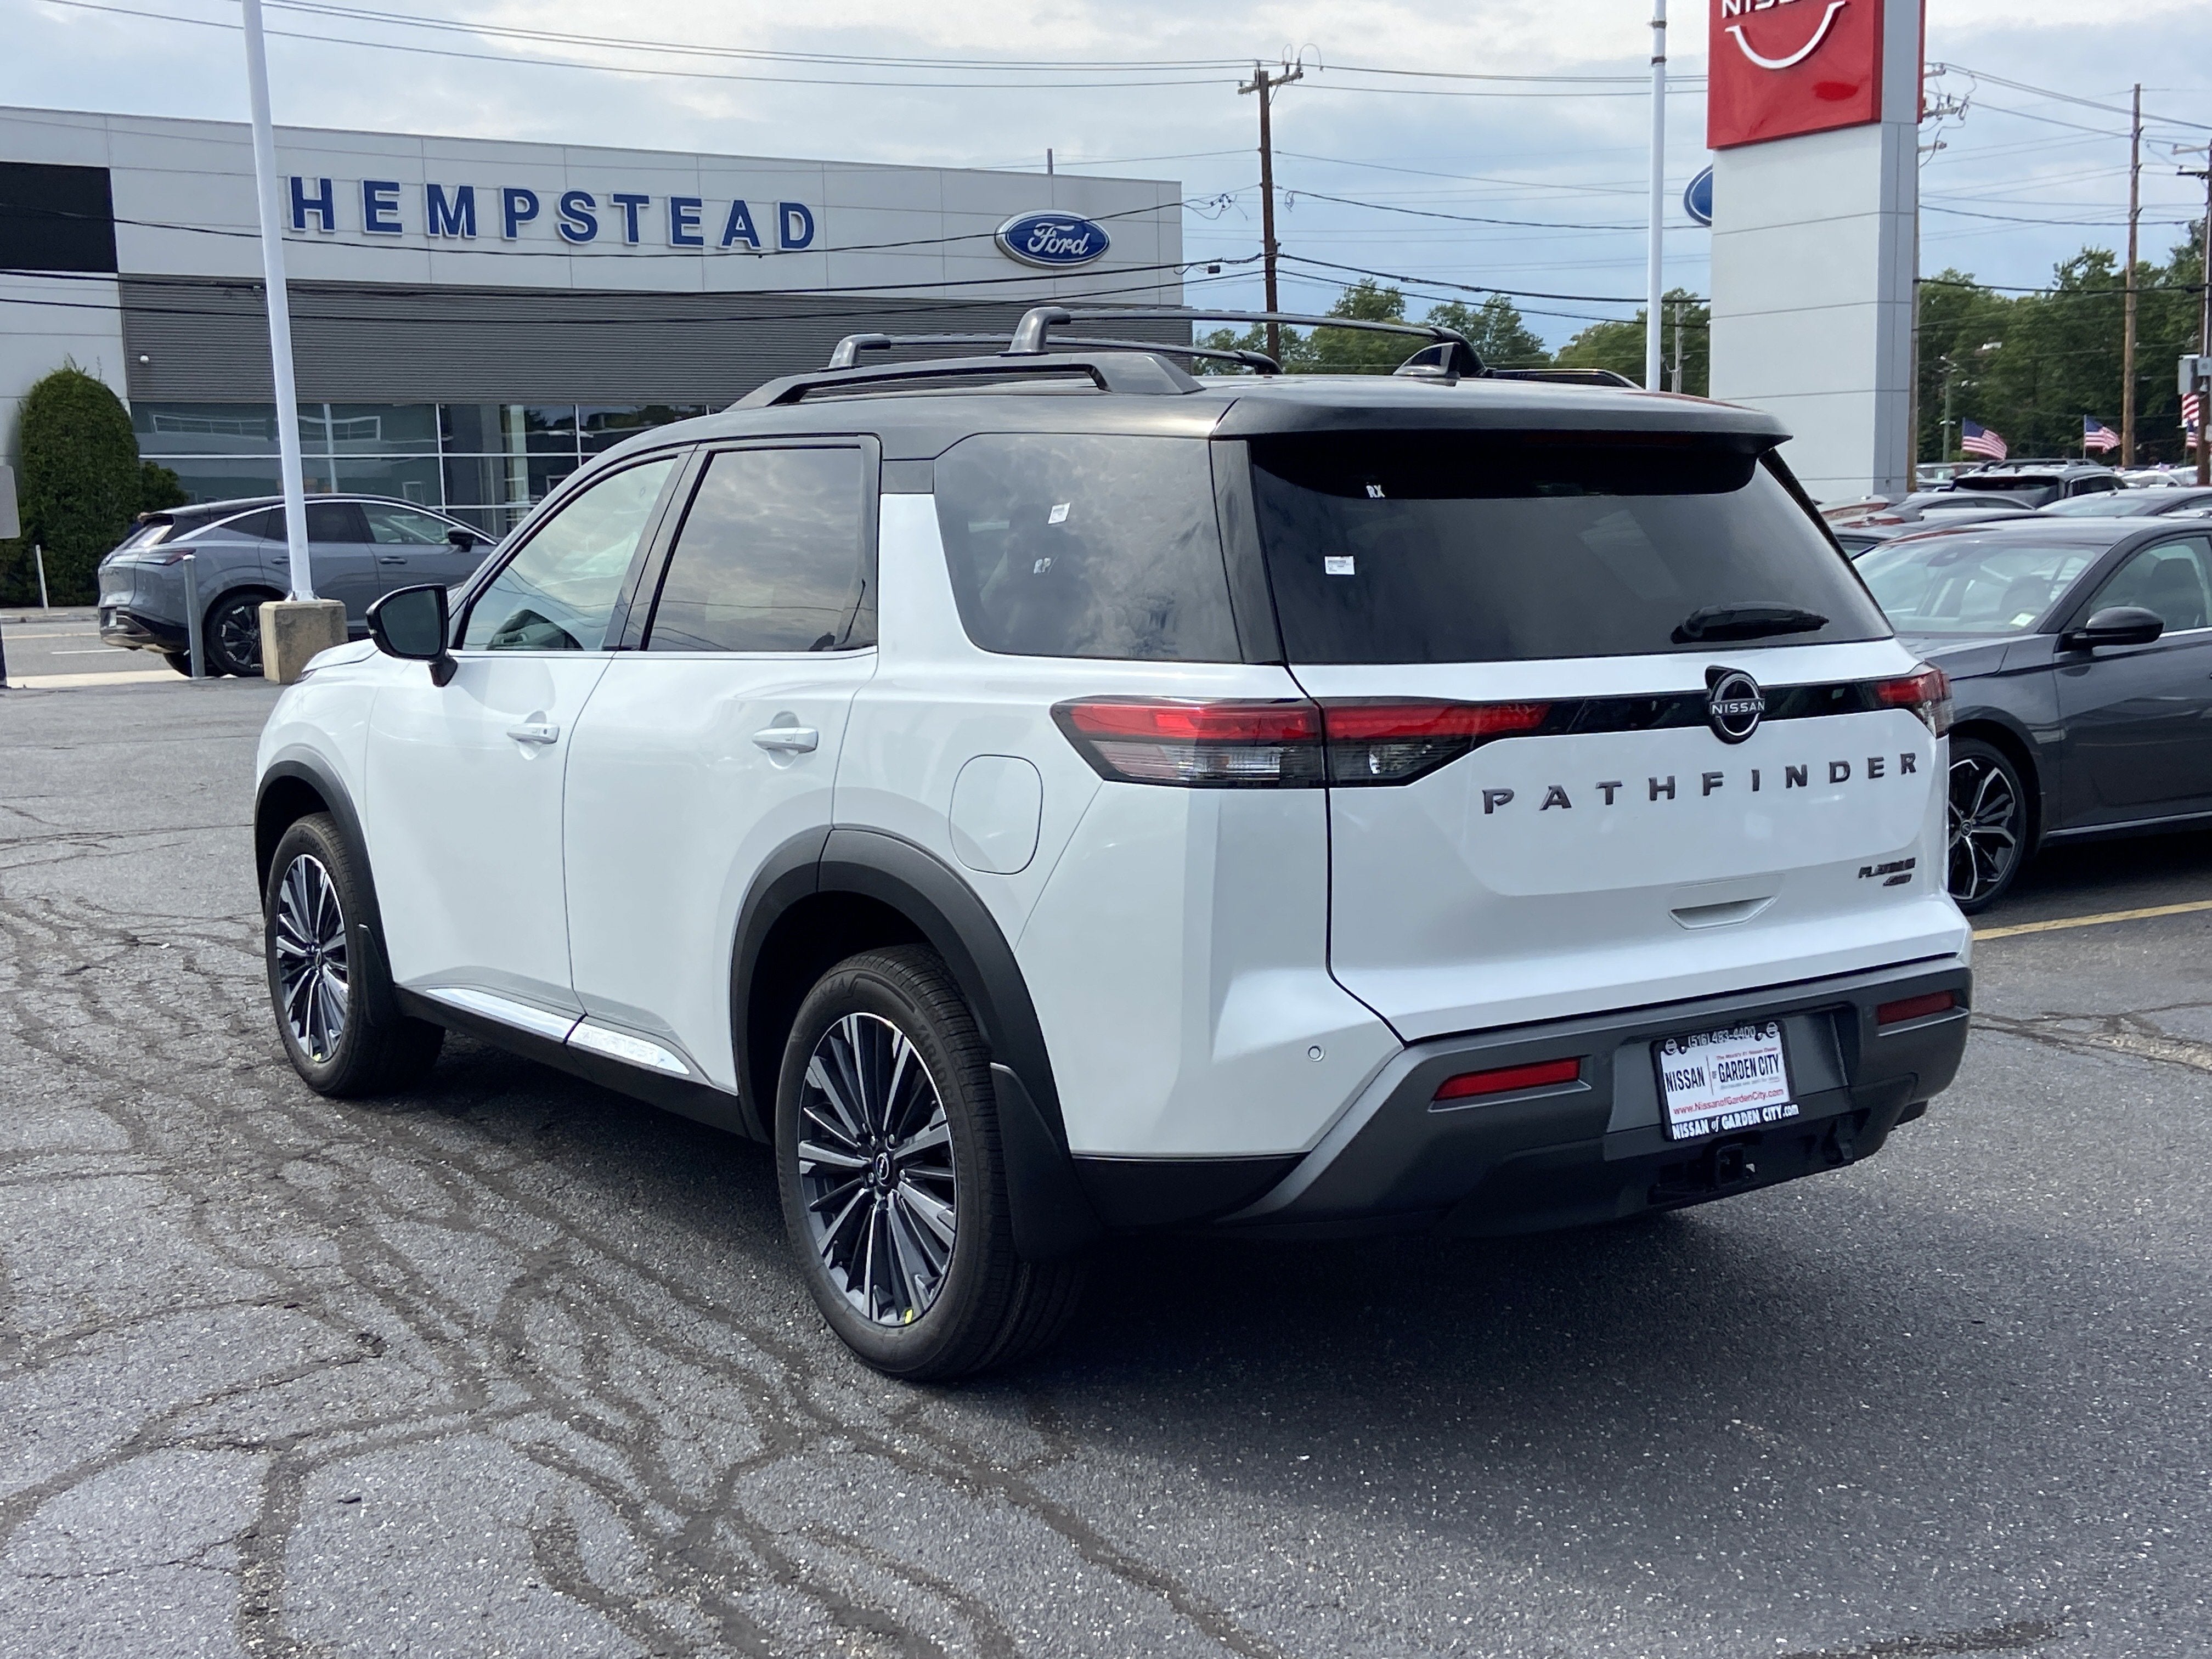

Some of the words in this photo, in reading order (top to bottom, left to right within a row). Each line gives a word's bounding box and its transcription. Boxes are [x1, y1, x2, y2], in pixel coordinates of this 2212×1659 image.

[287, 175, 815, 250] HEMPSTEAD
[1027, 223, 1090, 255] Ford
[1712, 701, 1765, 714] NISSAN
[1482, 752, 1917, 814] PATHFINDER
[1688, 1032, 1709, 1048] (516)
[1664, 1066, 1705, 1092] NISSAN
[1718, 1057, 1757, 1083] GARDEN
[1758, 1053, 1779, 1076] CITY
[1672, 1119, 1709, 1140] NISSAN
[1711, 1116, 1720, 1132] of
[1721, 1109, 1760, 1130] GARDEN
